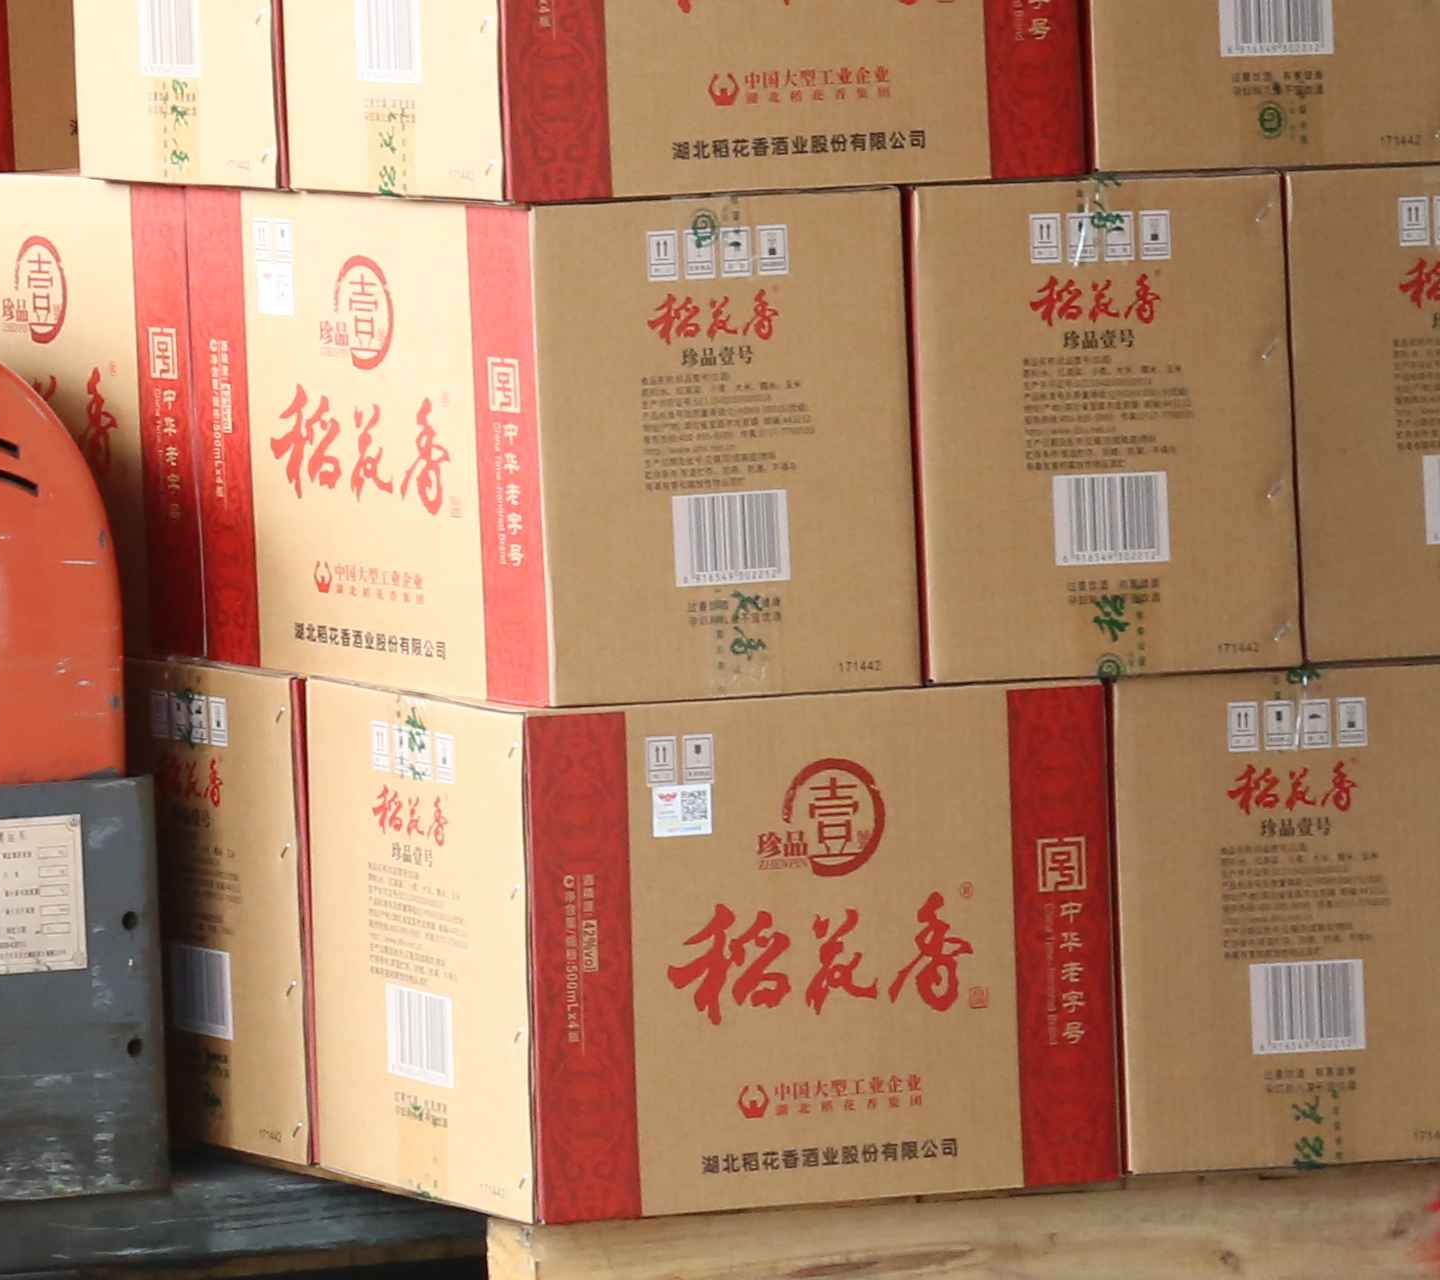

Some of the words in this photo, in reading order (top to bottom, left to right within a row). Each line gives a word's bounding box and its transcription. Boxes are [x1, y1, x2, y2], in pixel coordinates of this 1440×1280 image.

[744, 66, 890, 88] 中国大型工业企业
[672, 130, 927, 161] 湖北稻花香酒业股份有限公司
[646, 289, 779, 344] 稻花香
[1028, 272, 1161, 327] 稻花香
[680, 344, 754, 368] 珍品壹号
[1062, 327, 1136, 351] 珍品壹号
[271, 383, 451, 516] 稻花香
[502, 424, 524, 567] 中华老字号
[334, 565, 423, 590] 中国大型工业企业
[294, 622, 446, 660] 湖北稻花香酒业股份有限公司
[1224, 760, 1358, 814] 稻花香
[371, 783, 447, 848] 稻花香
[1259, 815, 1332, 839] 珍品壹号
[667, 891, 974, 1026] 稻花香
[1059, 901, 1087, 1044] 中华老字号
[774, 1074, 922, 1100] 中国大型工业企业
[701, 1138, 959, 1175] 湖北稻花香酒业股份有限公司
